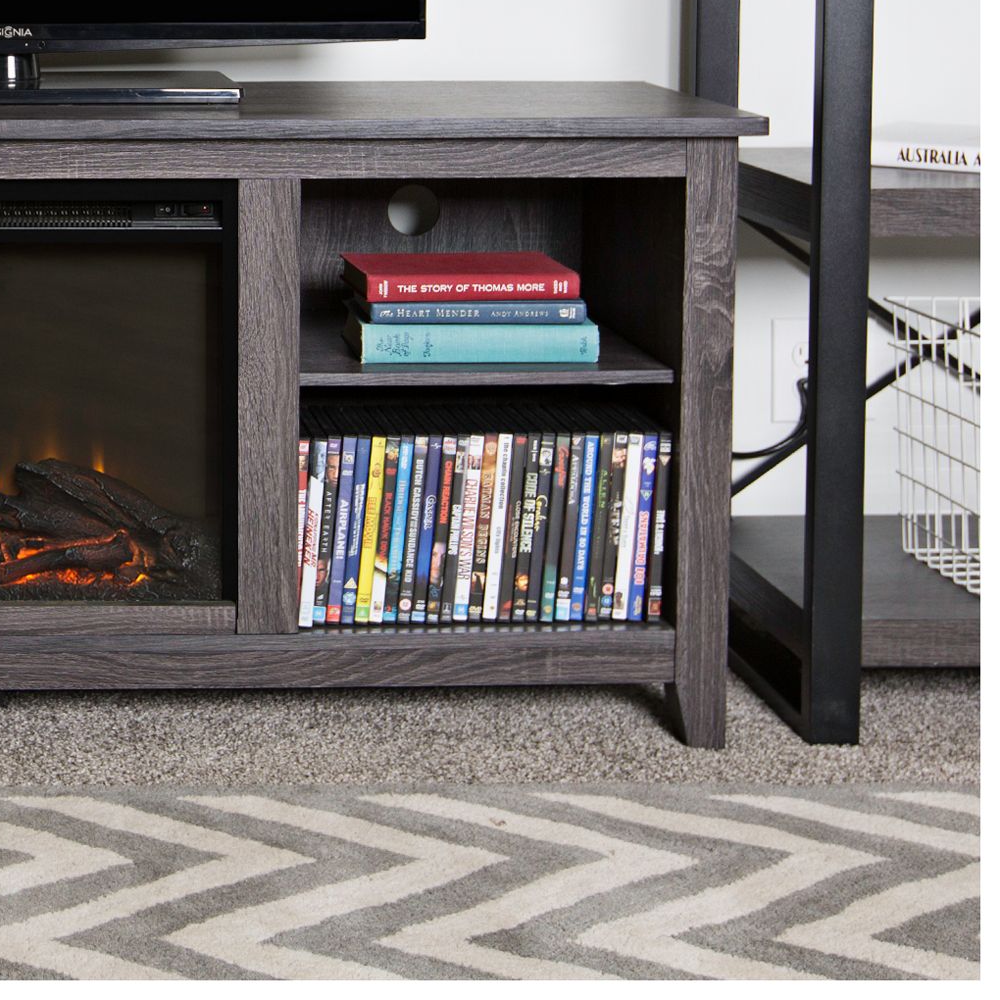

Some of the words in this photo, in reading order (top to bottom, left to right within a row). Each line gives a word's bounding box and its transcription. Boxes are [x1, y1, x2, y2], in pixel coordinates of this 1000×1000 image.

[897, 147, 968, 166] AUSTRALIA
[397, 284, 418, 293] THE
[420, 284, 453, 293] STORY
[456, 284, 470, 293] OF
[472, 283, 514, 292] THOMAS
[517, 283, 545, 291] MORE
[503, 442, 511, 454] the
[585, 440, 595, 476] AROUND
[415, 459, 424, 485] BUTCH
[445, 460, 453, 485] CHAIN
[524, 472, 539, 498] CODE
[583, 476, 593, 495] THE
[324, 490, 332, 519] AFTER
[384, 492, 393, 514] BLACK
[411, 487, 421, 520] CASSIDY
[440, 485, 451, 525] REACTION
[464, 479, 479, 513] CHARLIE
[480, 473, 494, 519] BATMAN
[498, 478, 507, 510] collection
[522, 499, 536, 512] OF
[580, 496, 591, 526] WORLD
[303, 508, 315, 566] HEINEKEN
[321, 524, 330, 553] EARTH
[336, 499, 349, 559] AIRPLANE!
[460, 513, 476, 557] WILSON'S
[519, 512, 534, 554] SILENCE
[578, 536, 587, 549] 80
[579, 527, 588, 536] IN
[407, 528, 417, 568] SUNDANCE
[475, 523, 489, 565] BEGINS
[457, 558, 470, 580] WAR
[577, 549, 586, 572] DAYS
[404, 569, 413, 583] KID
